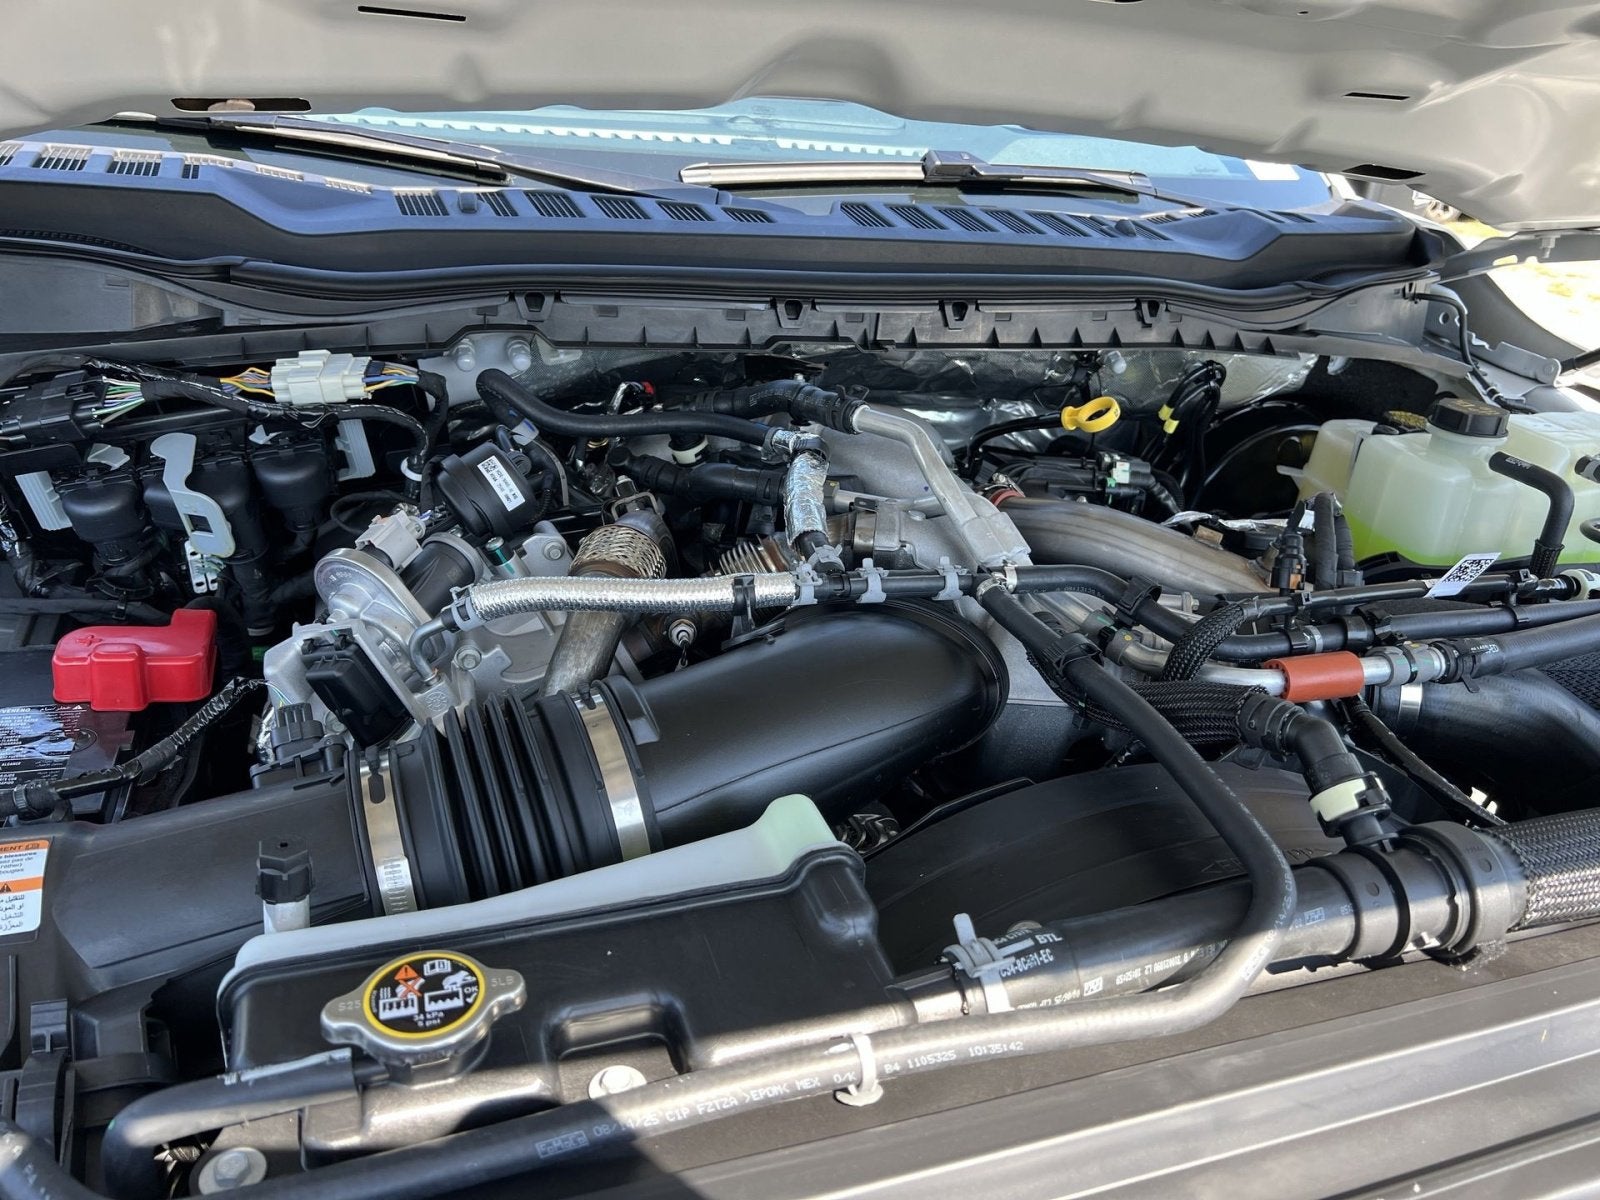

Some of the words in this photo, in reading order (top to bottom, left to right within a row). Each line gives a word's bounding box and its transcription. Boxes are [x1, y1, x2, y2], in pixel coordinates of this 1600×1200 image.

[1035, 933, 1063, 944] BTL
[464, 985, 478, 994] OK
[426, 1012, 445, 1020] kPa
[426, 1019, 441, 1027] psi
[593, 1115, 660, 1137] 08/14/25
[665, 1107, 690, 1122] CIP
[794, 1077, 821, 1091] MEX
[907, 1050, 957, 1069] 1105325
[968, 1041, 1024, 1058] 10:35:42
